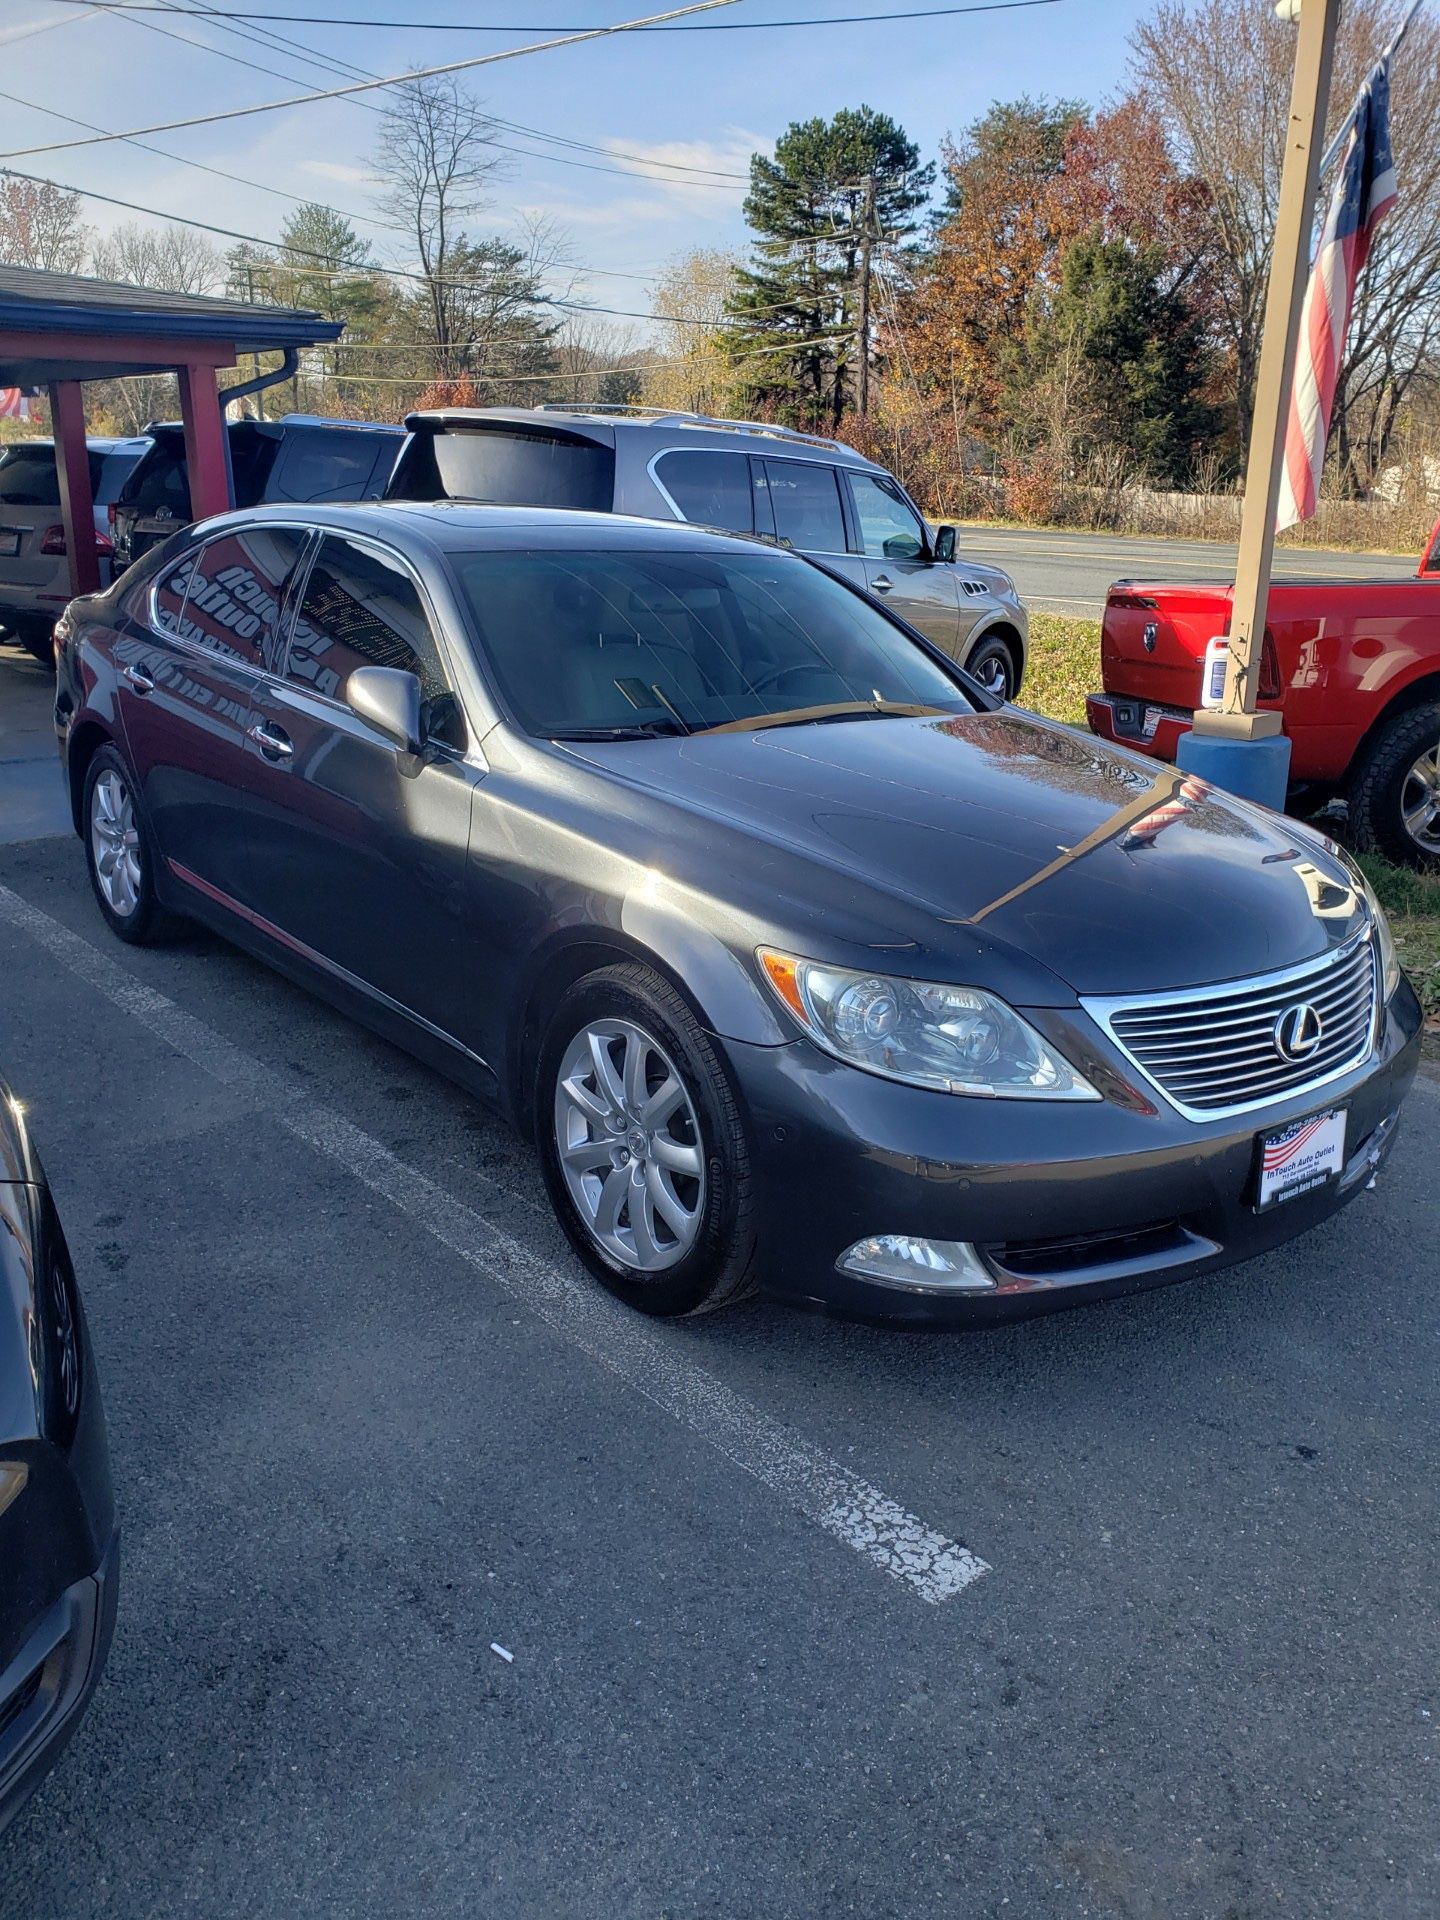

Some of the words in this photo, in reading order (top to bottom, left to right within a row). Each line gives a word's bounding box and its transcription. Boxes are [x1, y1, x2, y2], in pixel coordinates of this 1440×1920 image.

[1267, 1162, 1296, 1179] InTouch
[1298, 1156, 1313, 1167] Auto
[1315, 1144, 1335, 1159] Outlet
